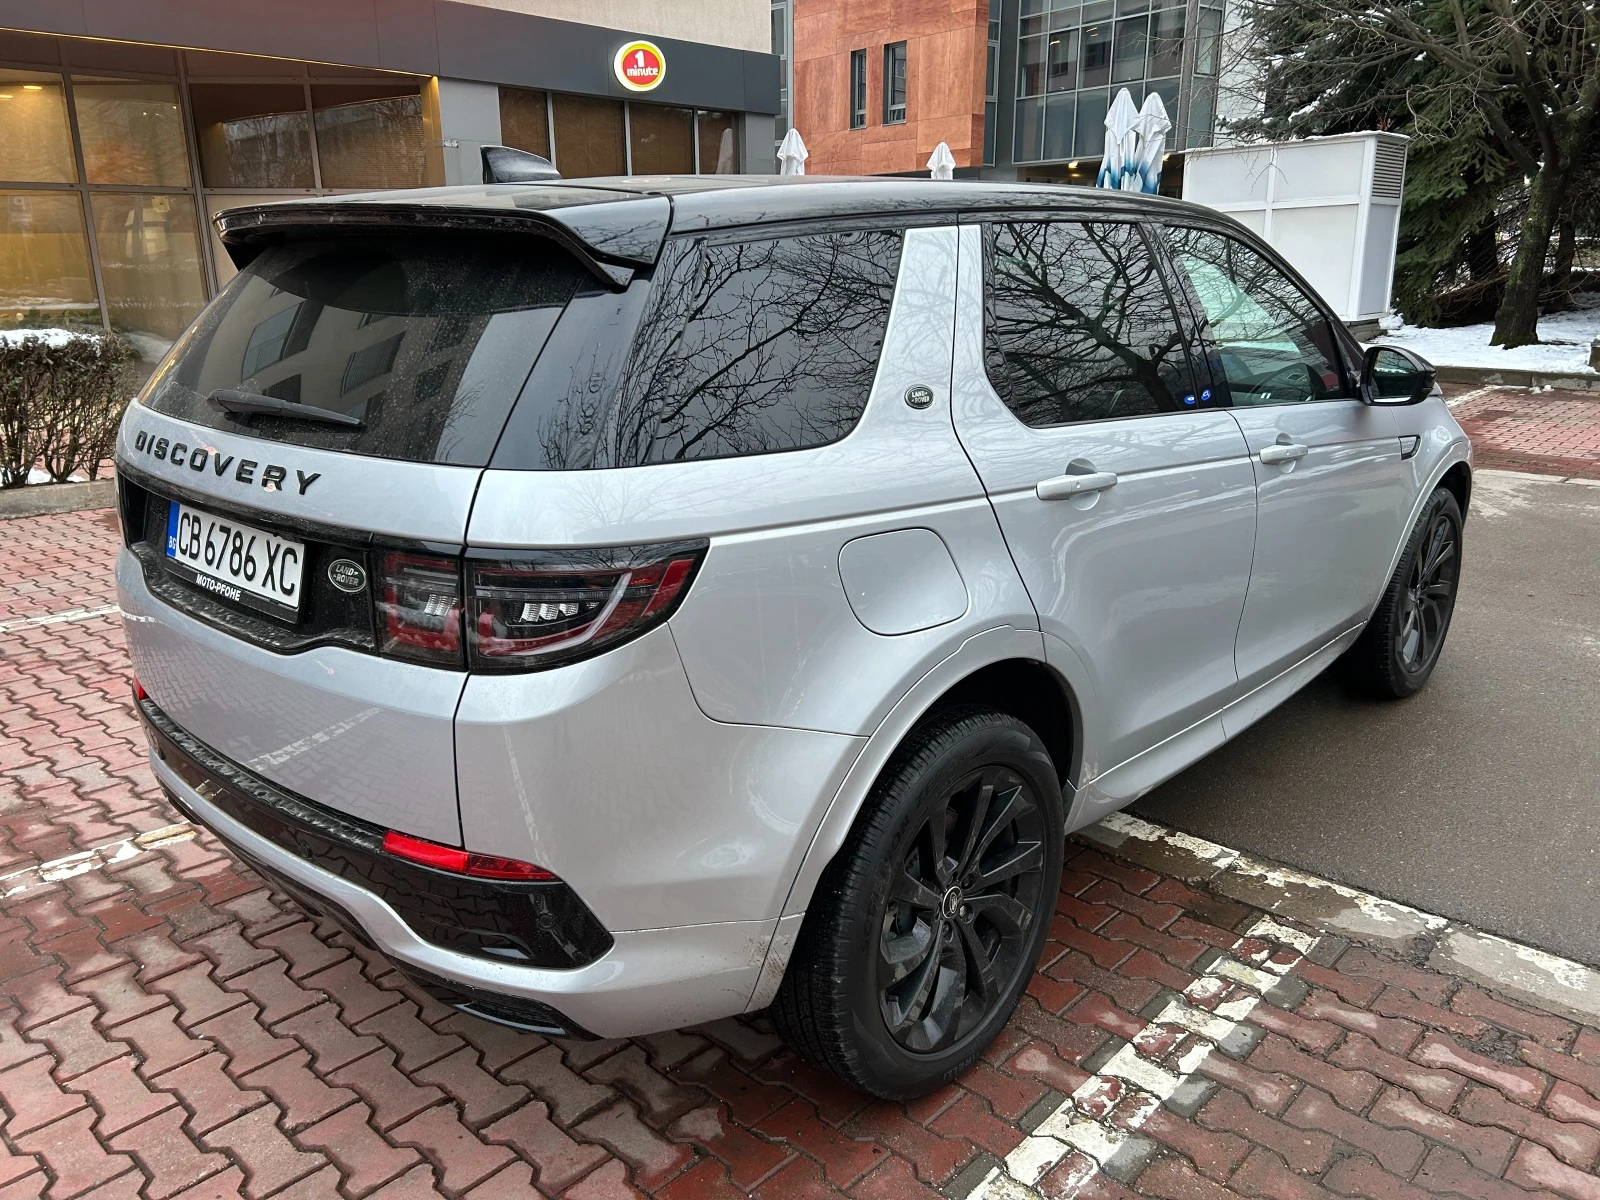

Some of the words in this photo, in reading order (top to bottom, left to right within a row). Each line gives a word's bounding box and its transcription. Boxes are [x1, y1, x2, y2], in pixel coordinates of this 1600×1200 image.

[626, 64, 659, 77] minute
[634, 50, 645, 68] 1
[134, 430, 321, 496] DISCOVERY
[204, 521, 257, 582] 6786
[261, 539, 298, 597] XC
[195, 573, 242, 602] MOTO-PFOHE
